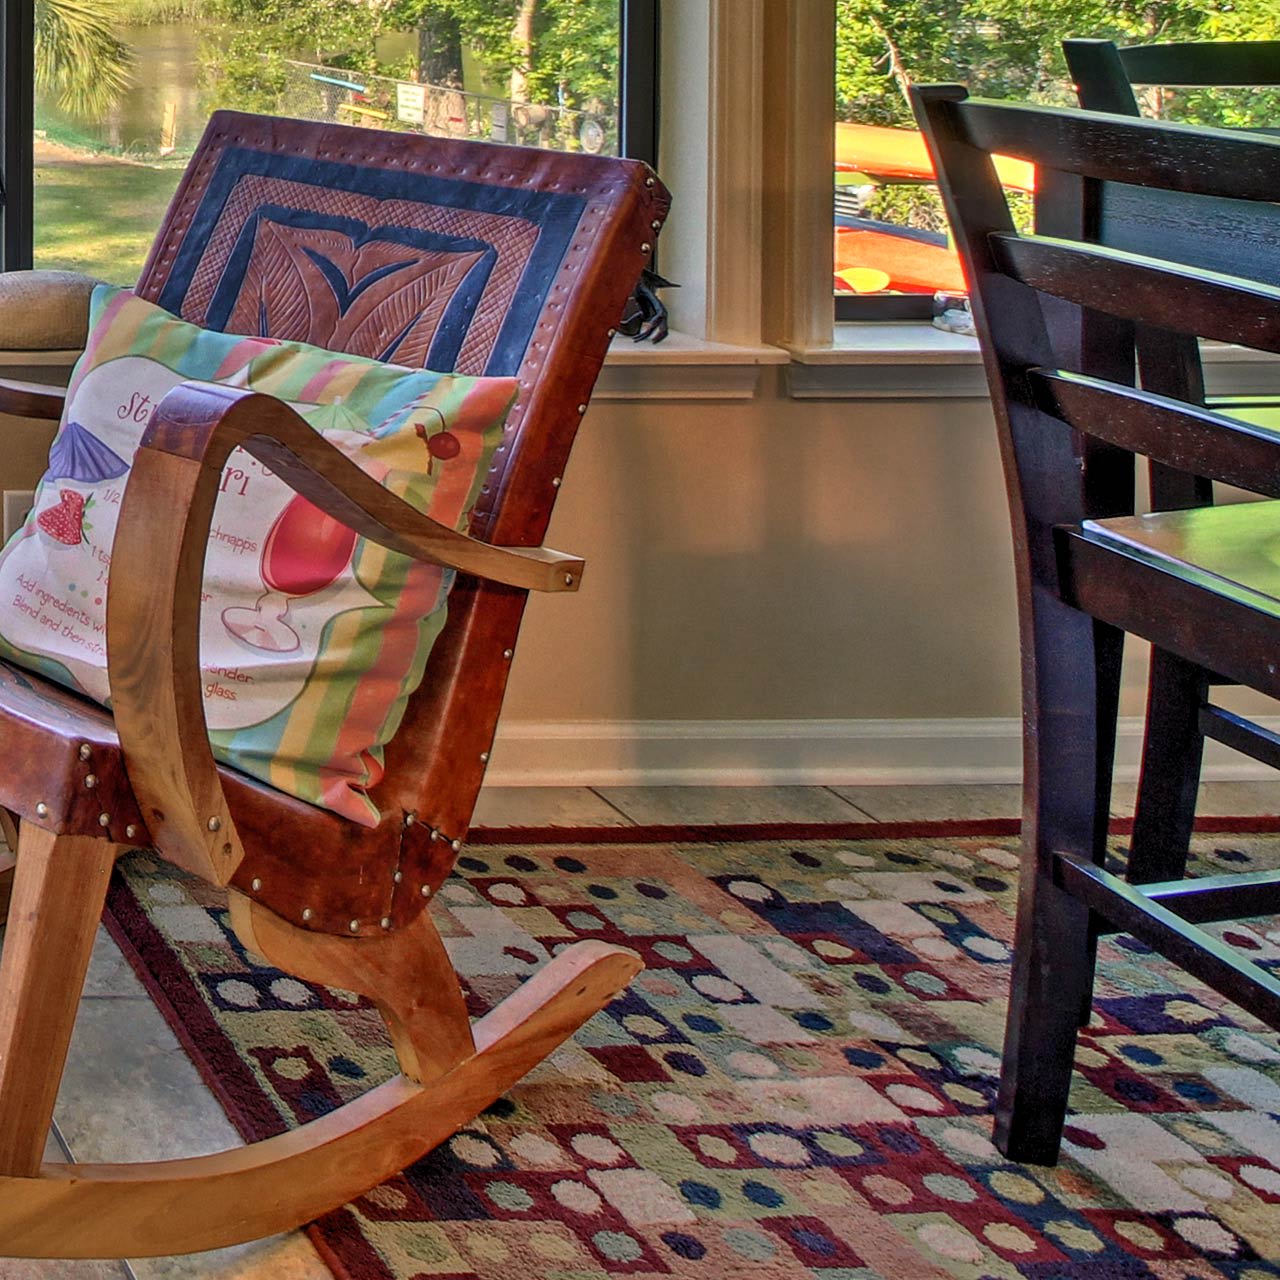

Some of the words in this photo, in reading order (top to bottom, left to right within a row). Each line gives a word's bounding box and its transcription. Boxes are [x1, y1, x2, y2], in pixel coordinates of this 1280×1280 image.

[13, 594, 42, 619] Blend
[40, 615, 62, 631] and
[62, 626, 85, 645] then
[16, 573, 37, 592] Add
[35, 589, 90, 626] ingredients
